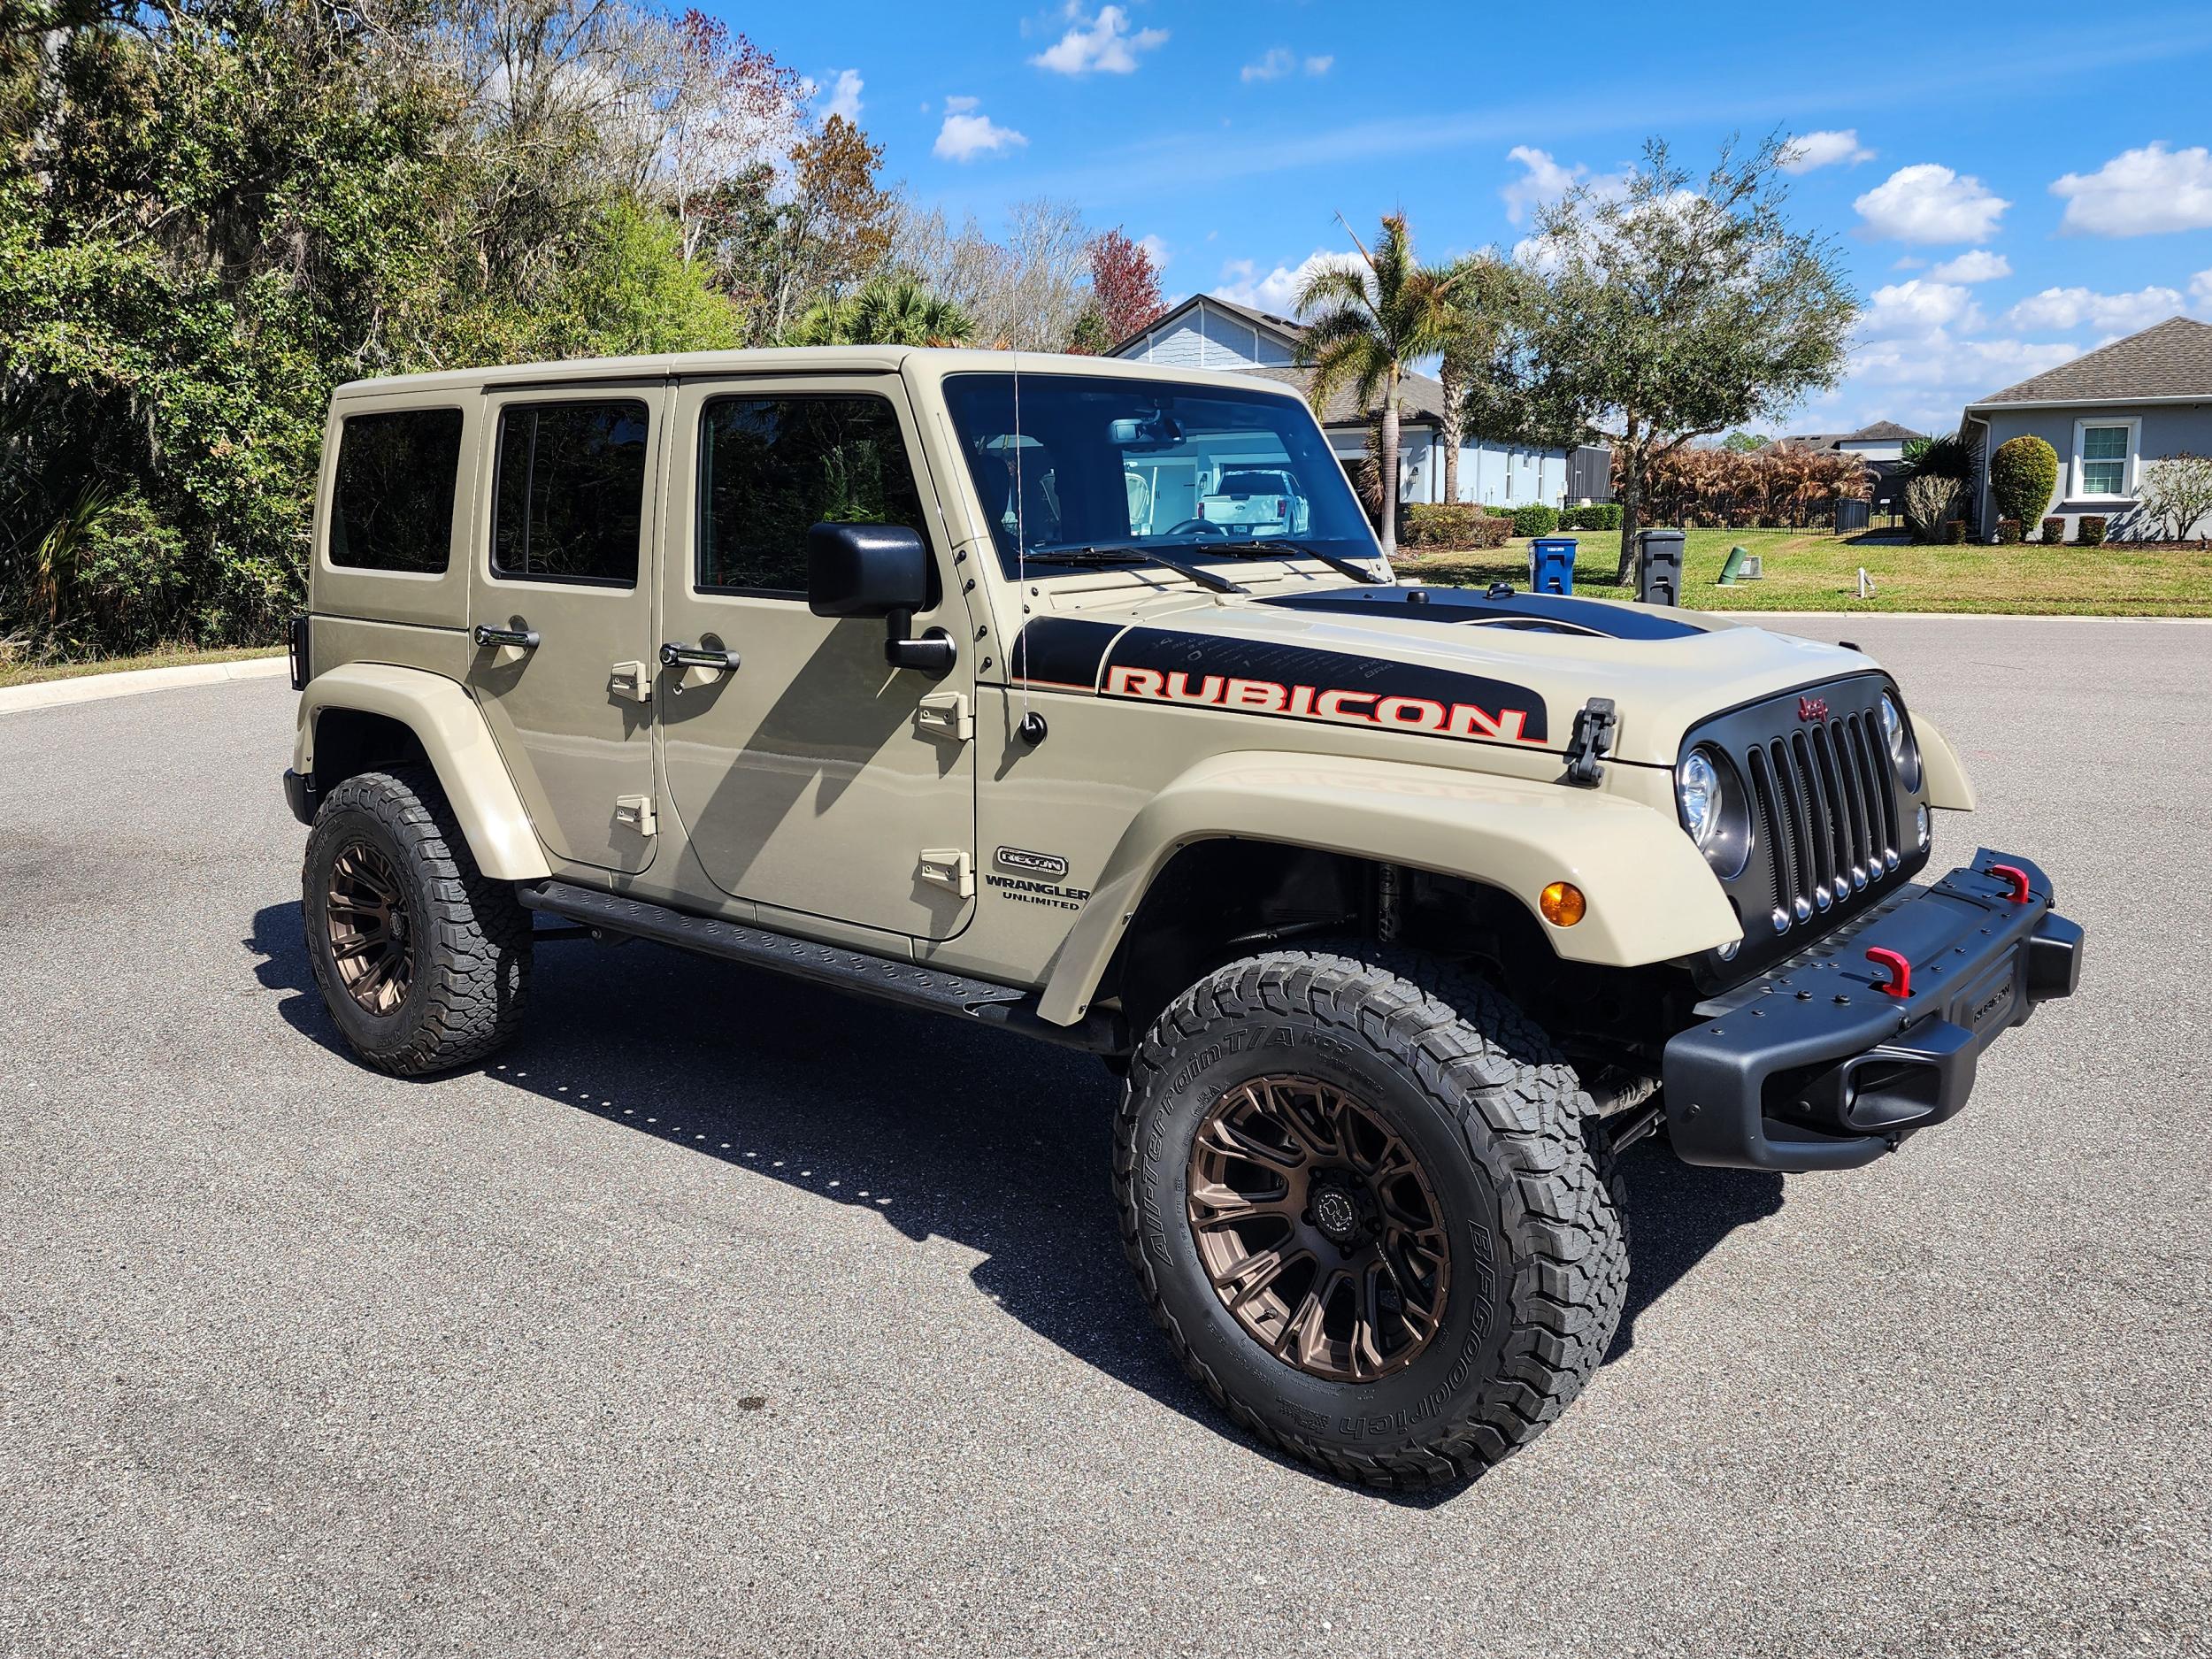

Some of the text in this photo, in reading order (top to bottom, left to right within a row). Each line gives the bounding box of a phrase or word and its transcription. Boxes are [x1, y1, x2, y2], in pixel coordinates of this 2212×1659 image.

[1107, 666, 1529, 742] RUBICON
[1798, 696, 1828, 722] Jeep
[1001, 851, 1063, 871] RECON
[985, 874, 1091, 902] WRANGLER
[1002, 891, 1080, 910] UNLIMITED
[1142, 1045, 1222, 1266] All-Terrain
[1224, 1025, 1295, 1054] T/A
[1338, 1219, 1495, 1440] BFGoodrich
